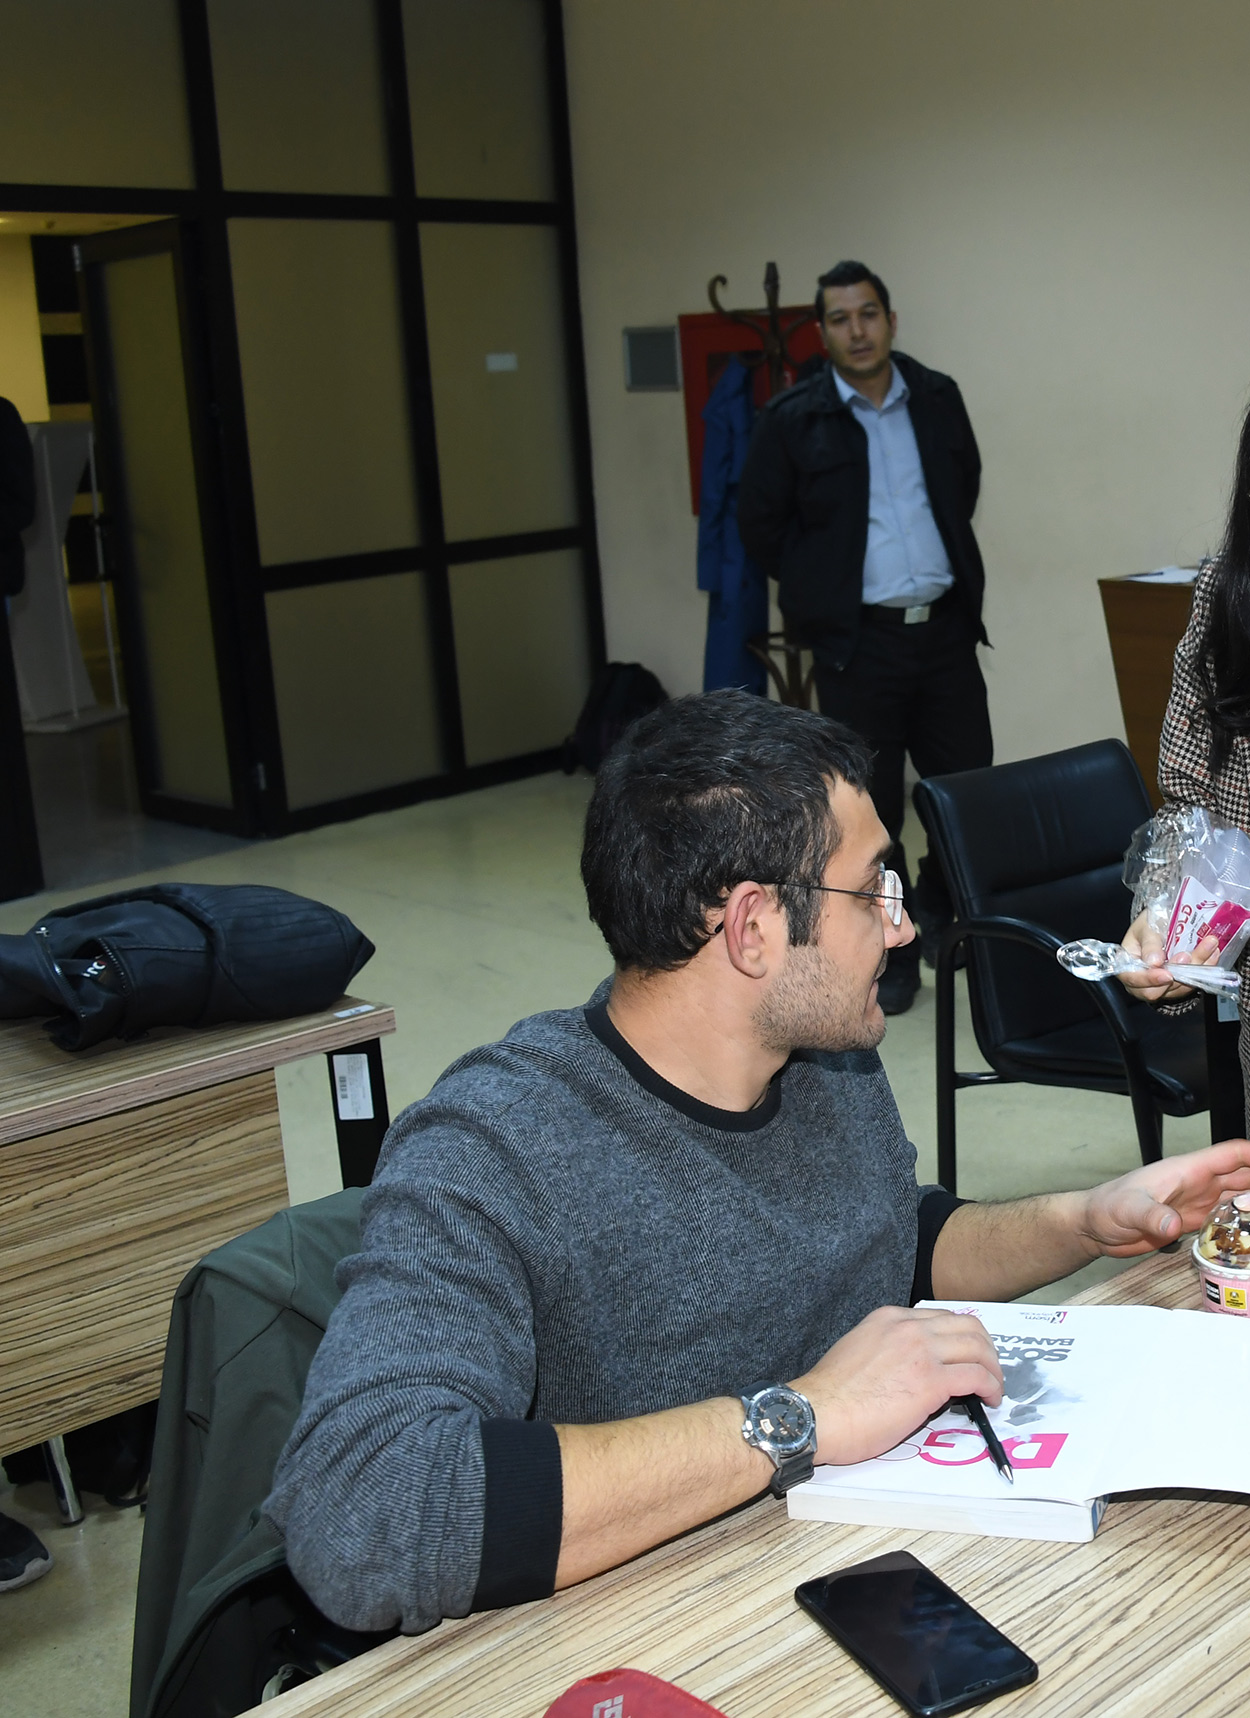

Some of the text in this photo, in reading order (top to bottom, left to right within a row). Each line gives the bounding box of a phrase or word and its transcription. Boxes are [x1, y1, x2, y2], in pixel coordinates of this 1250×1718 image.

[1174, 904, 1193, 947] OLD
[990, 1333, 1075, 1346] BANKAS
[997, 1346, 1071, 1362] SOR
